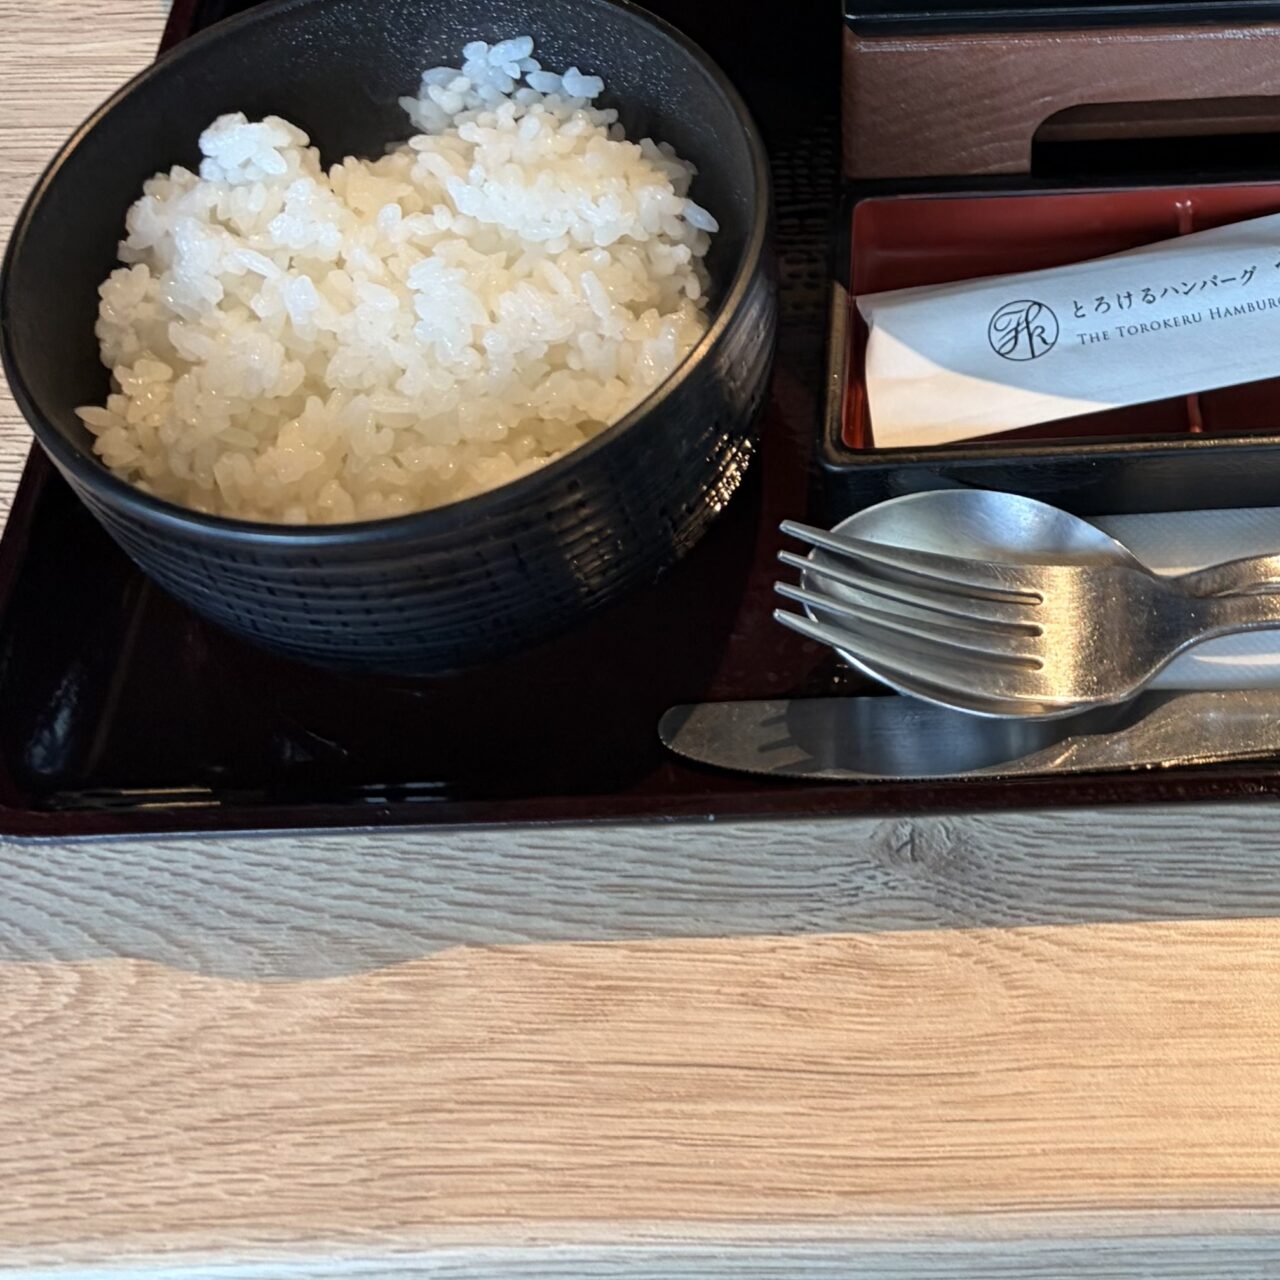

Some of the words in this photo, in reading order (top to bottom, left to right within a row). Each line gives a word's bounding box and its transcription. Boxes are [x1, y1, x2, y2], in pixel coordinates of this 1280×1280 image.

[1072, 264, 1258, 319] とろけるハンバーグ
[1077, 330, 1110, 346] THE
[1115, 312, 1203, 340] TOROKERU
